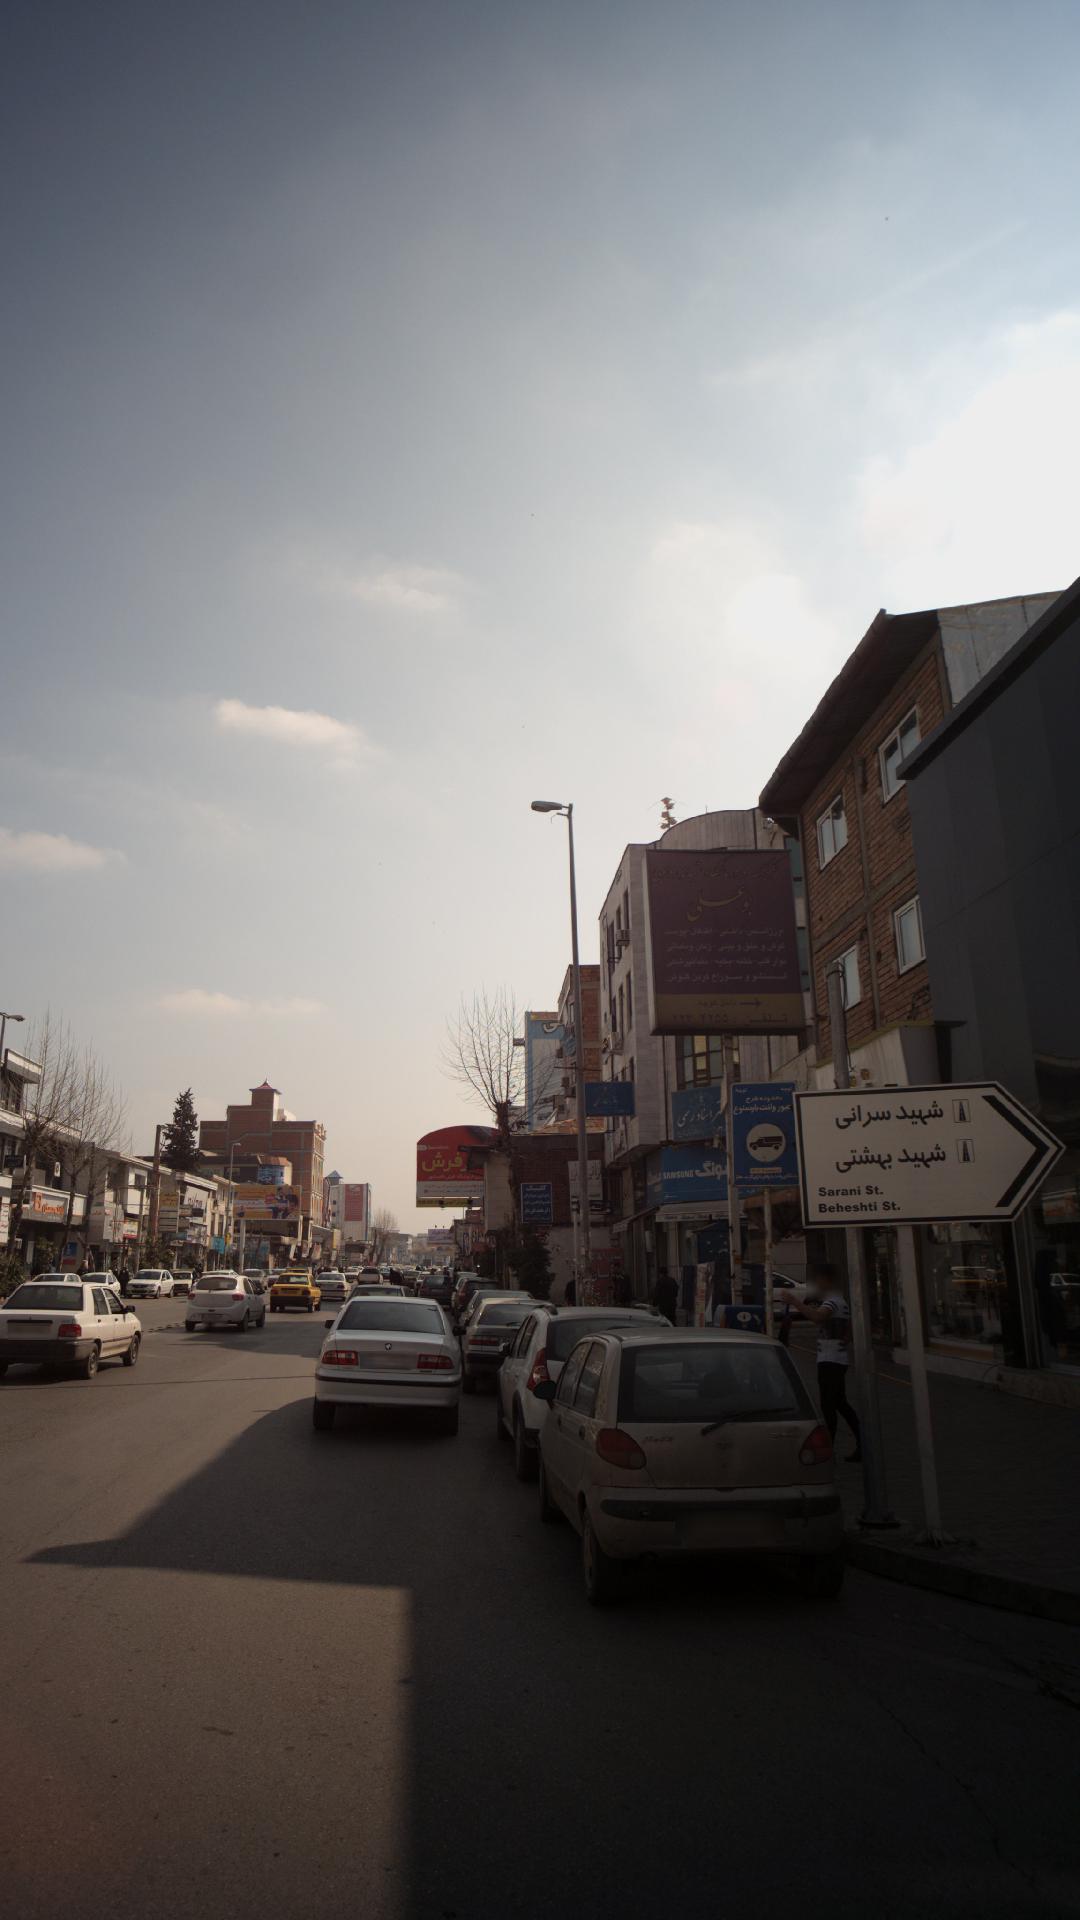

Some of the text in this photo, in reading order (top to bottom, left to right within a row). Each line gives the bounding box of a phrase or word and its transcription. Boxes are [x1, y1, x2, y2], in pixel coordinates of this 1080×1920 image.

[836, 1101, 943, 1130] شهید سرانی
[836, 1144, 945, 1173] شهید بهشتی
[818, 1184, 884, 1197] Sarani St.
[818, 1200, 902, 1214] Beheshti St.
